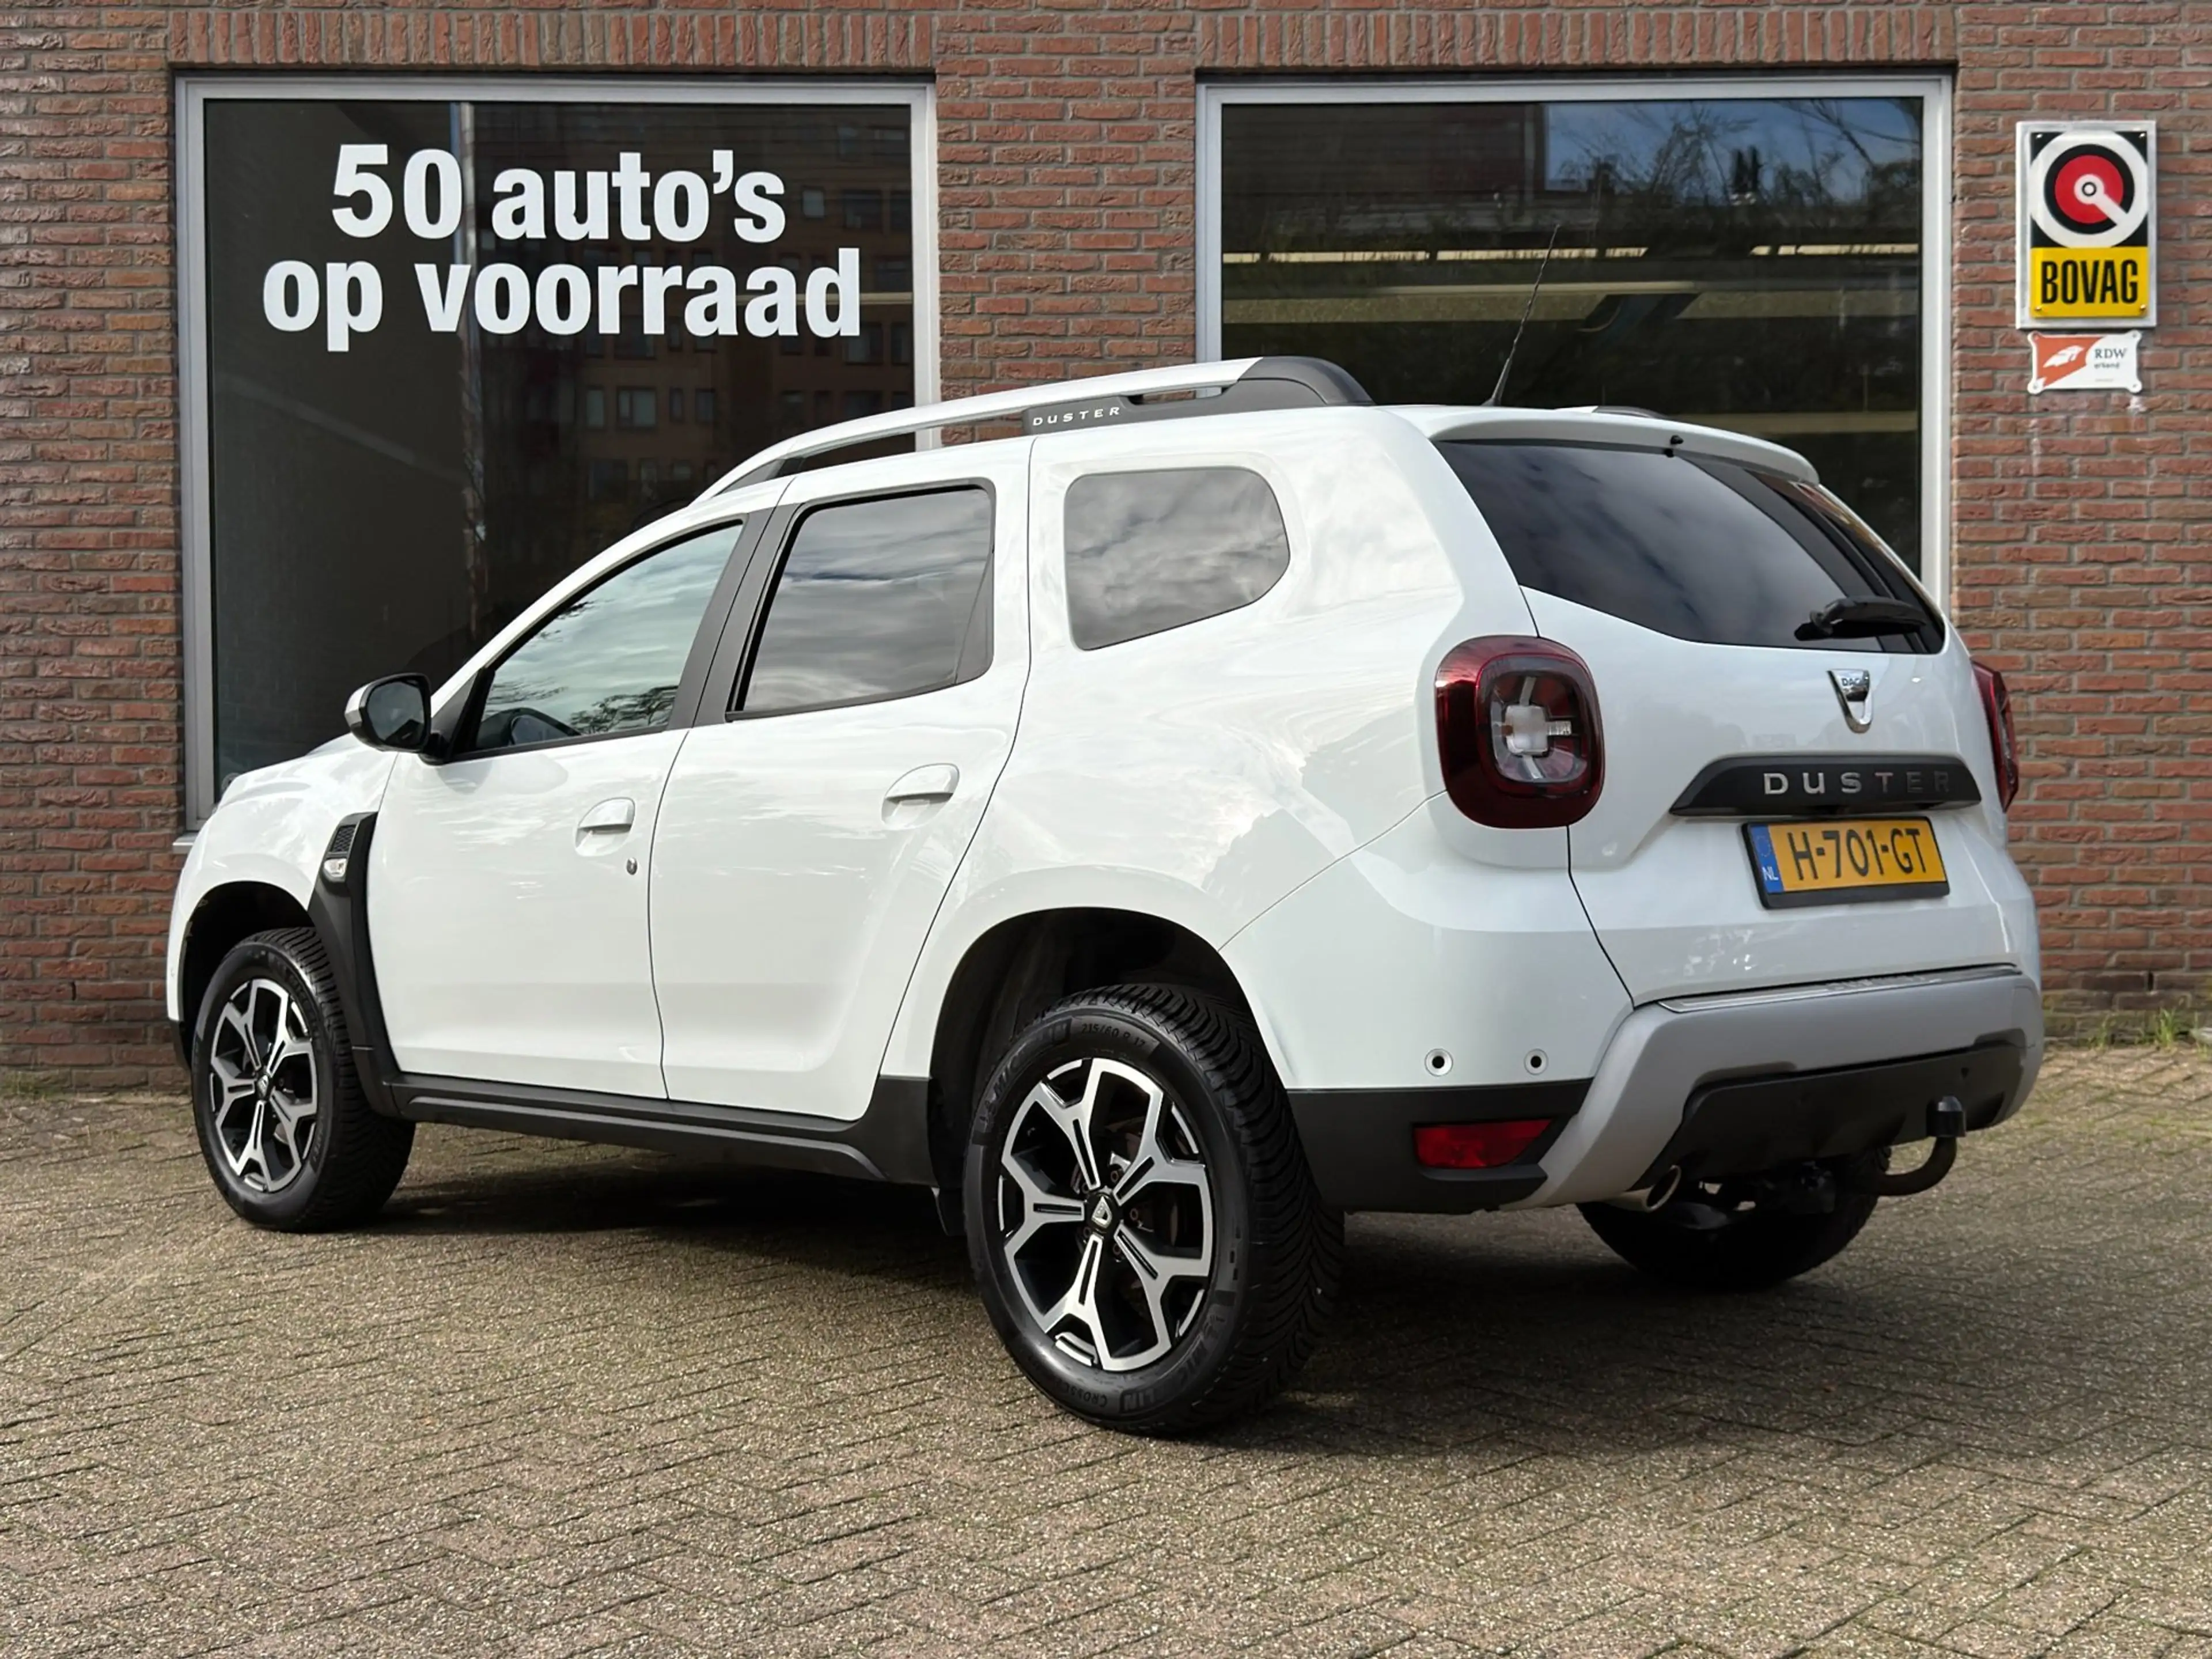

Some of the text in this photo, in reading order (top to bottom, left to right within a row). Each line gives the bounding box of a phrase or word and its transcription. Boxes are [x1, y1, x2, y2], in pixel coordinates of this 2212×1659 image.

[332, 144, 785, 243] 50 auto's
[2041, 259, 2138, 305] BOVAG
[263, 248, 860, 352] op voorraad
[2094, 348, 2127, 358] RDW
[1032, 406, 1120, 426] DUSTER
[1763, 771, 1950, 795] DUSTER
[1787, 828, 1927, 881] H-701-GT
[1762, 866, 1779, 881] NL
